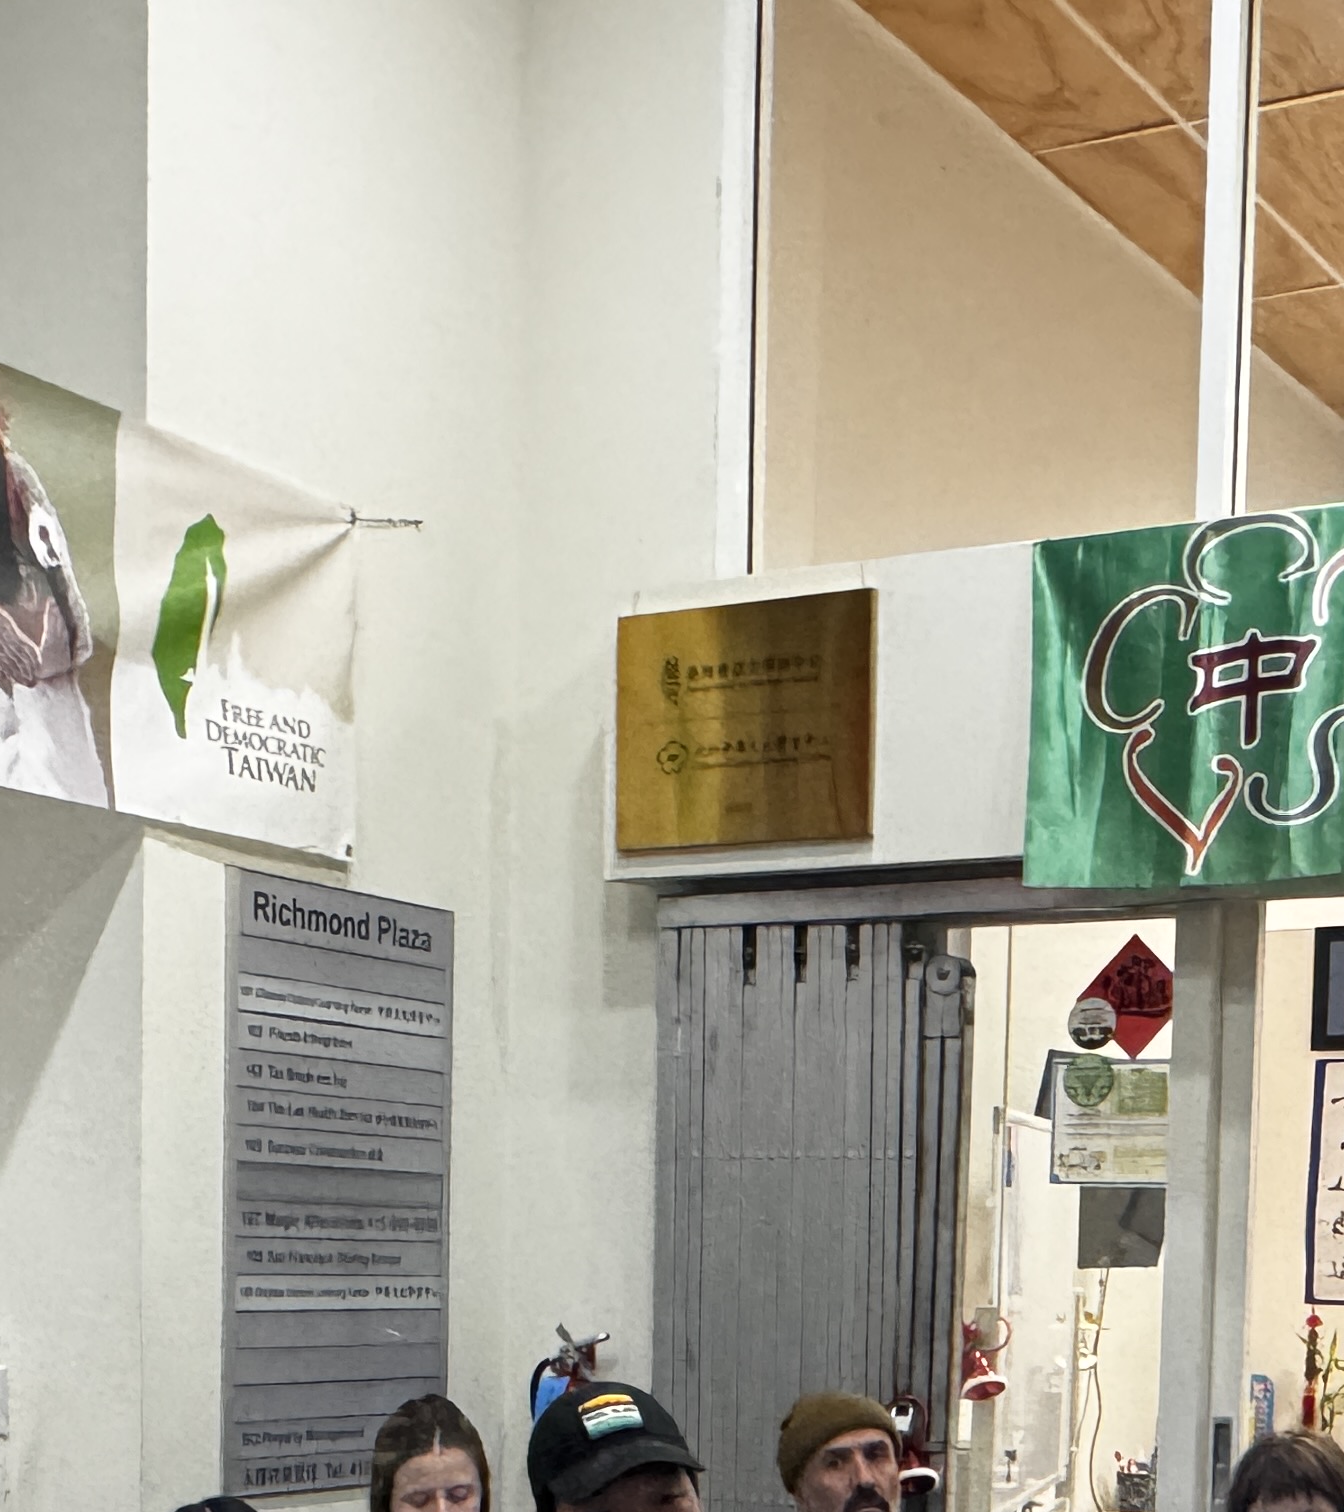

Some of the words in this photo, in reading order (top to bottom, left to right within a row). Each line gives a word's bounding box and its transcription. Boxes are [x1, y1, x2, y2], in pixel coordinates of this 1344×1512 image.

[220, 698, 265, 729] FREE
[269, 714, 312, 740] AND
[206, 719, 327, 768] DEMOCRATIC
[221, 746, 317, 793] TAIWAN
[253, 890, 370, 941] Richmond
[377, 914, 432, 952] Plaza
